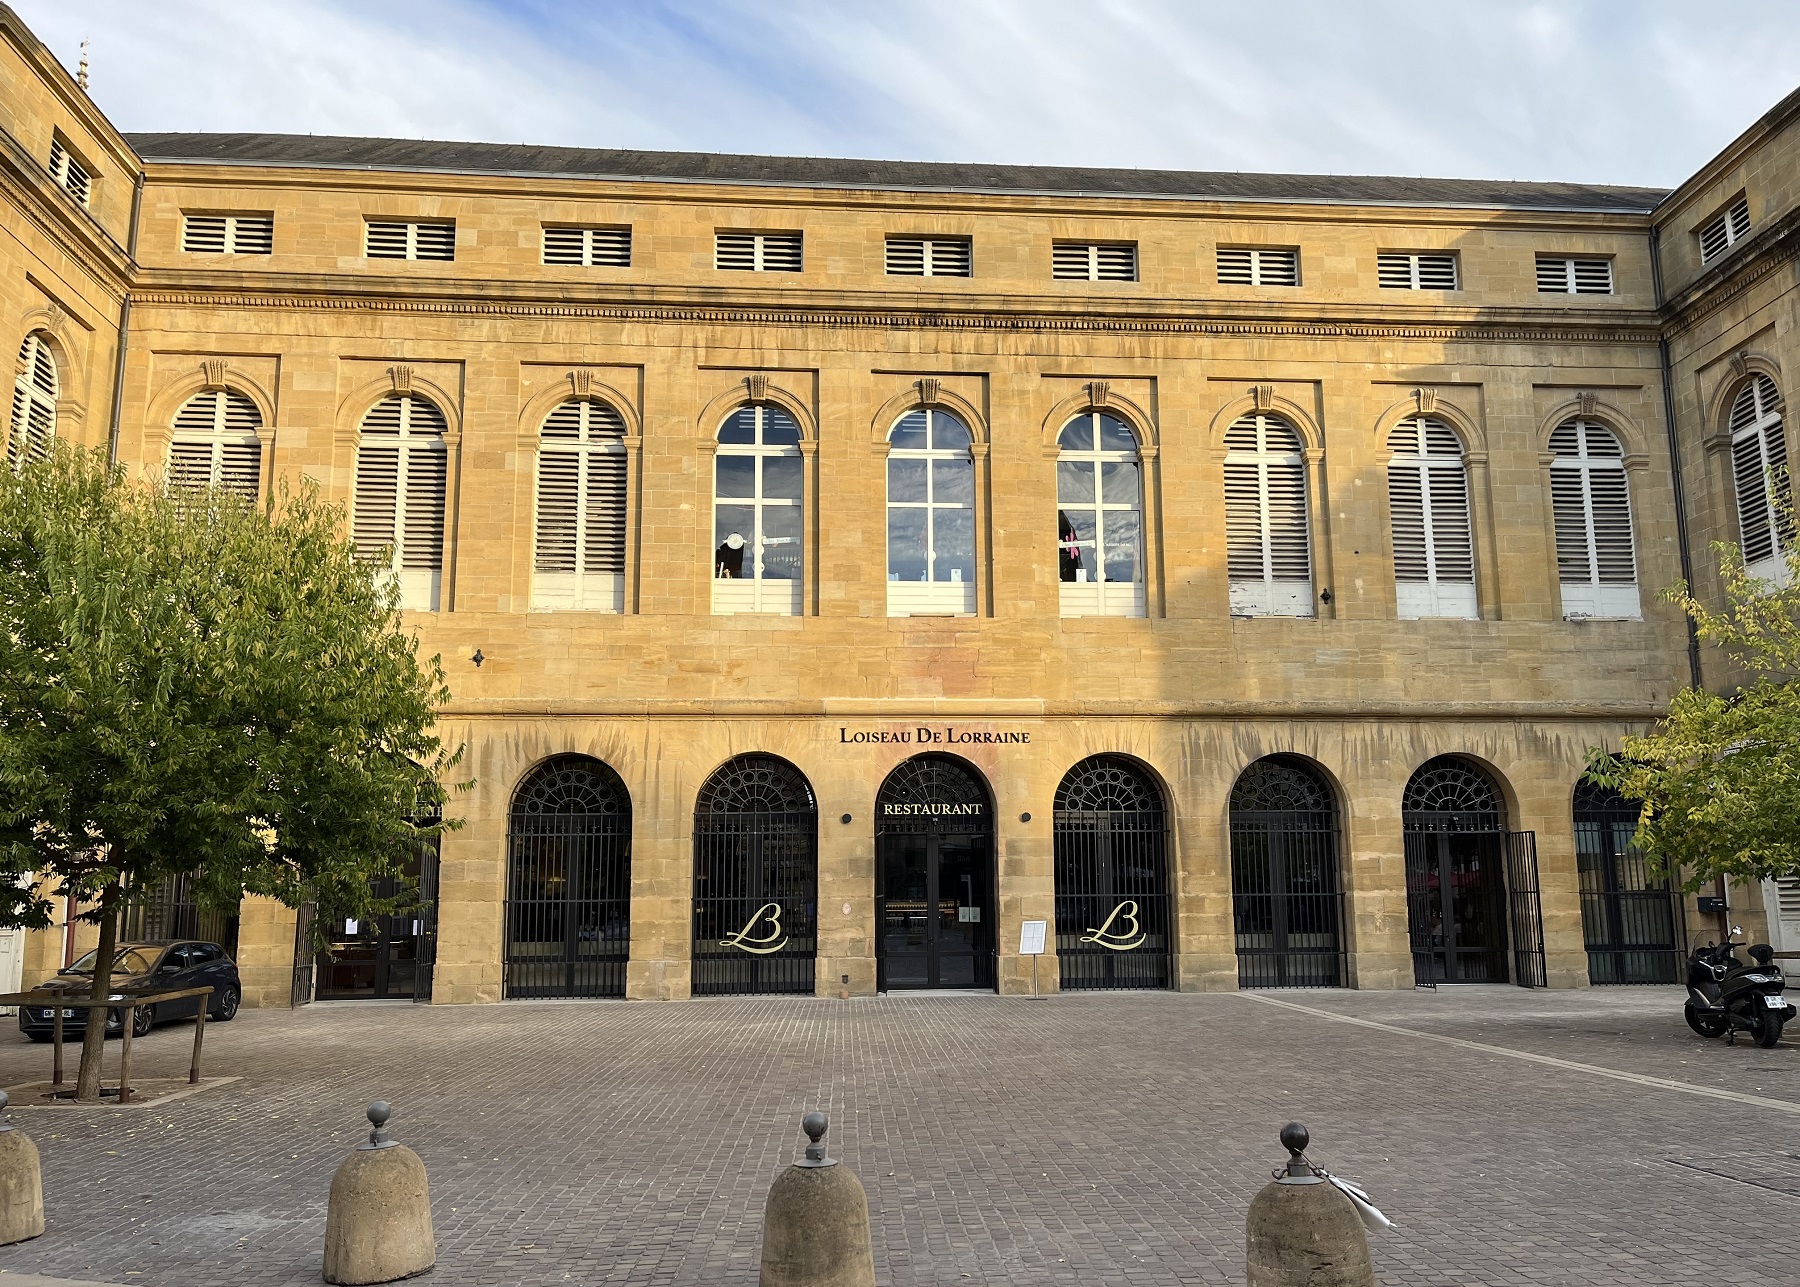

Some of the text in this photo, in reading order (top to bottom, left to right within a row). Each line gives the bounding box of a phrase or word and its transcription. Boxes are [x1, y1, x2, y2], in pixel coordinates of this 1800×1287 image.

[840, 728, 1031, 743] LOISEAU DE LORRAINE
[884, 804, 982, 815] RESTAURANT
